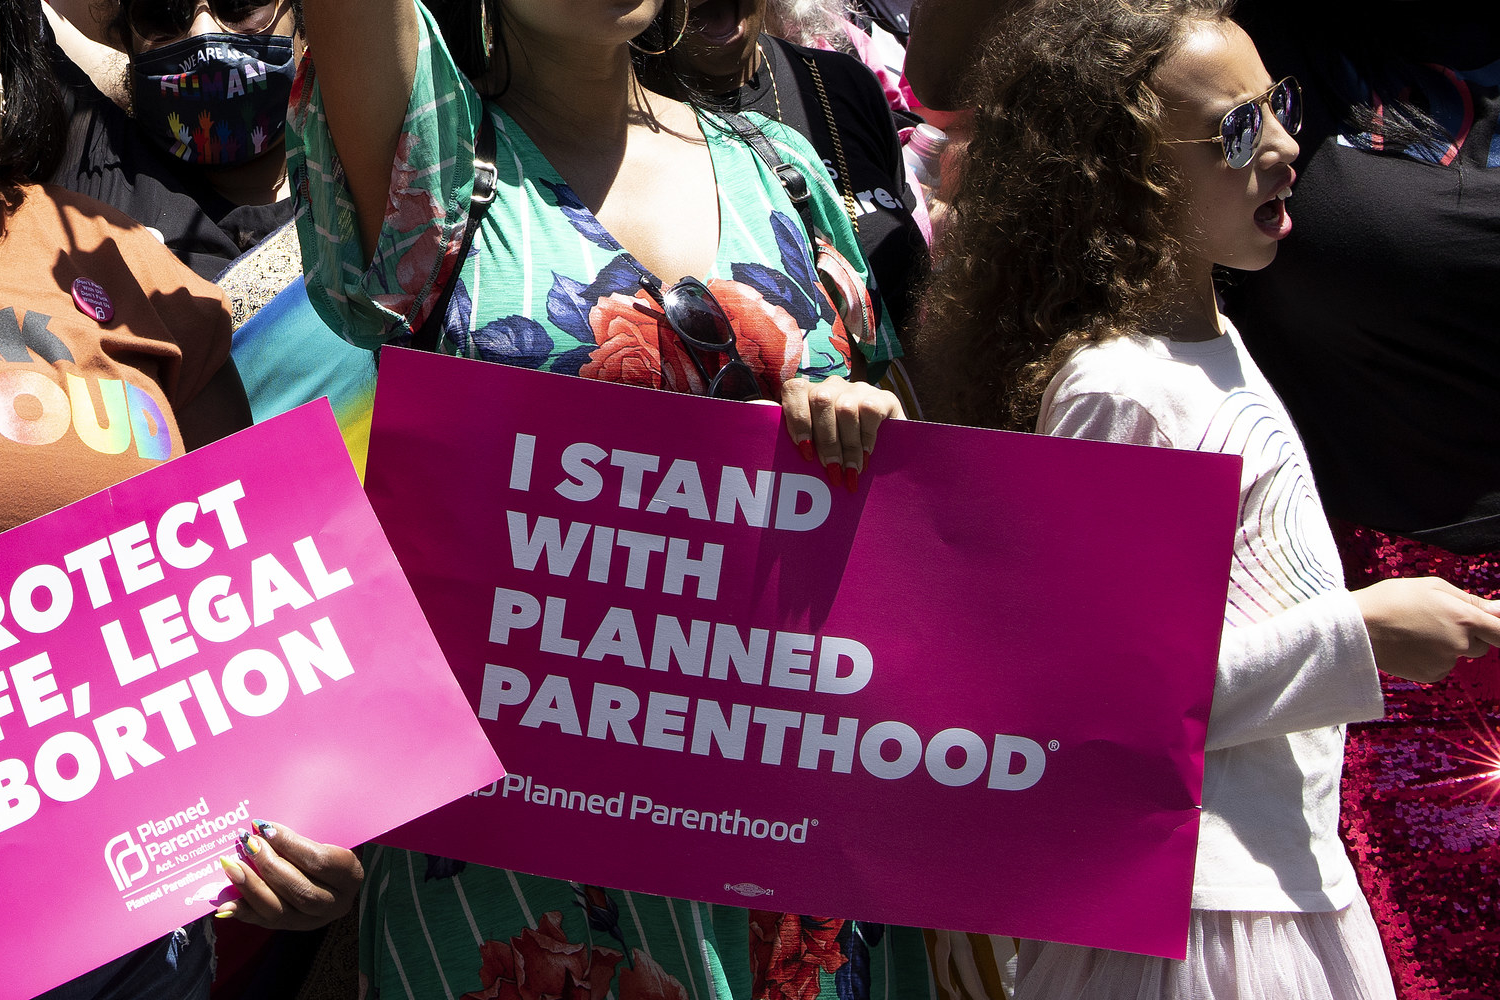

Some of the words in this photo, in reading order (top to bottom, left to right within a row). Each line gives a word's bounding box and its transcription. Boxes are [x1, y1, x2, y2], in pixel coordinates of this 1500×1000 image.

[179, 54, 197, 72] WE
[197, 47, 226, 62] ARE
[510, 433, 536, 491] I
[554, 443, 831, 531] STAND
[507, 510, 724, 600] WITH
[100, 535, 354, 686] LEGAL
[489, 587, 873, 694] PLANNED
[502, 773, 625, 818] Planned
[137, 797, 210, 842] Planned
[155, 862, 175, 875] Act.
[176, 853, 188, 865] No
[190, 841, 216, 858] matter
[216, 830, 238, 848] what.
[125, 888, 164, 911] Planned
[161, 864, 214, 895] Parenthood
